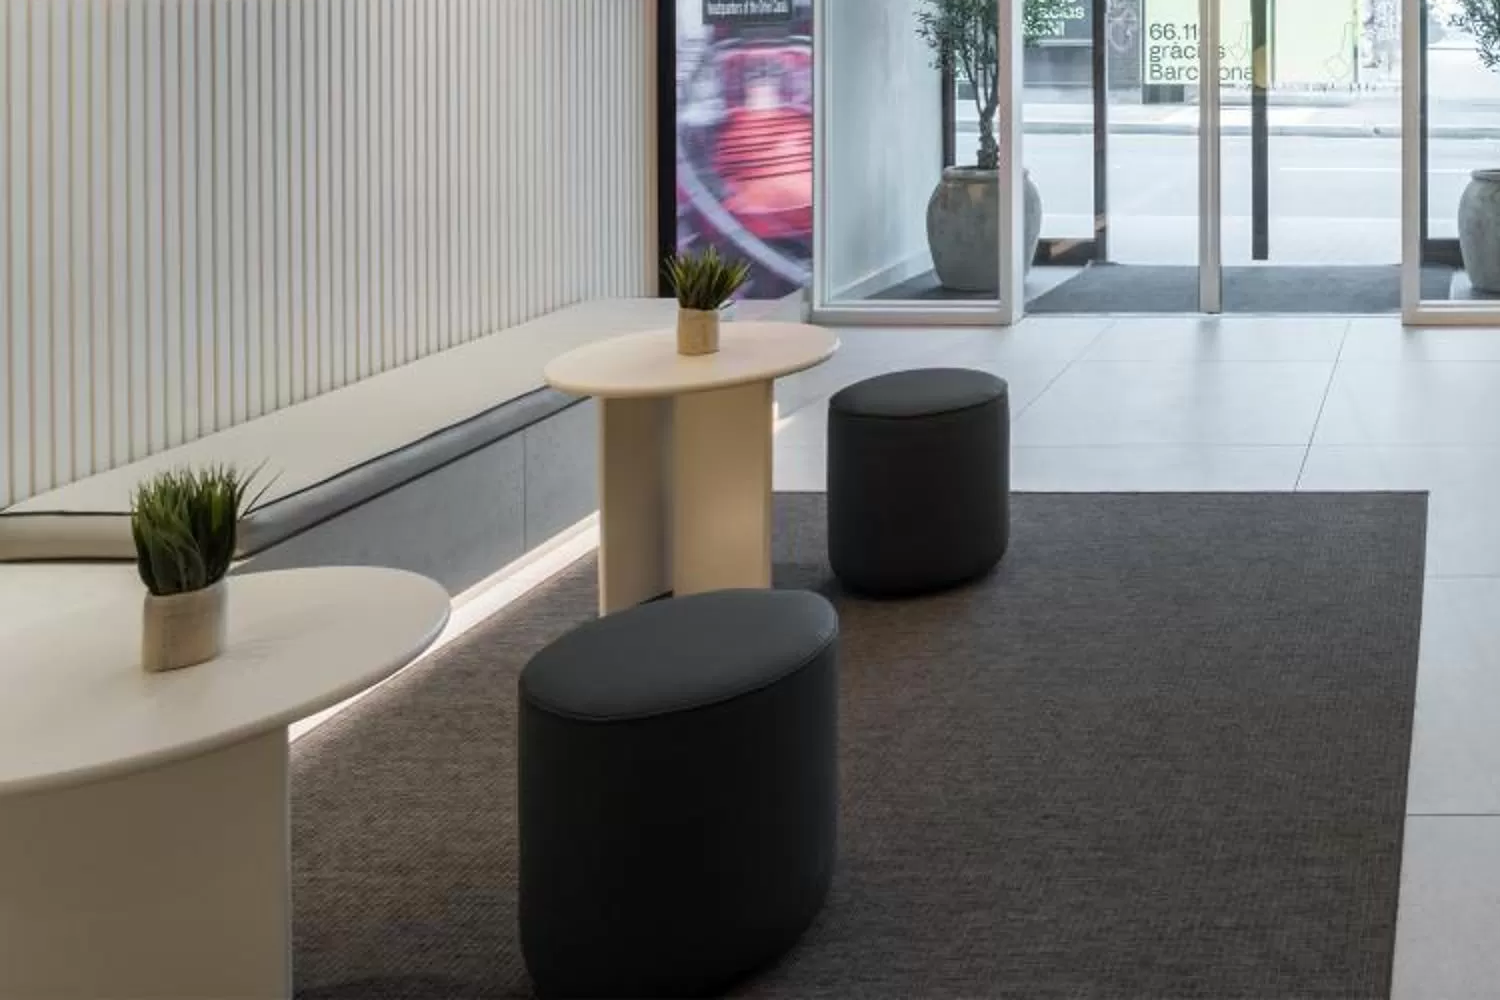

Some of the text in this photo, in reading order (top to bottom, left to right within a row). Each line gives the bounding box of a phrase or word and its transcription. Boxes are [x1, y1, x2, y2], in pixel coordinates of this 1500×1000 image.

[1149, 23, 1200, 41] 66.11
[1149, 41, 1226, 63] gràcis
[1149, 63, 1254, 81] Barcona
